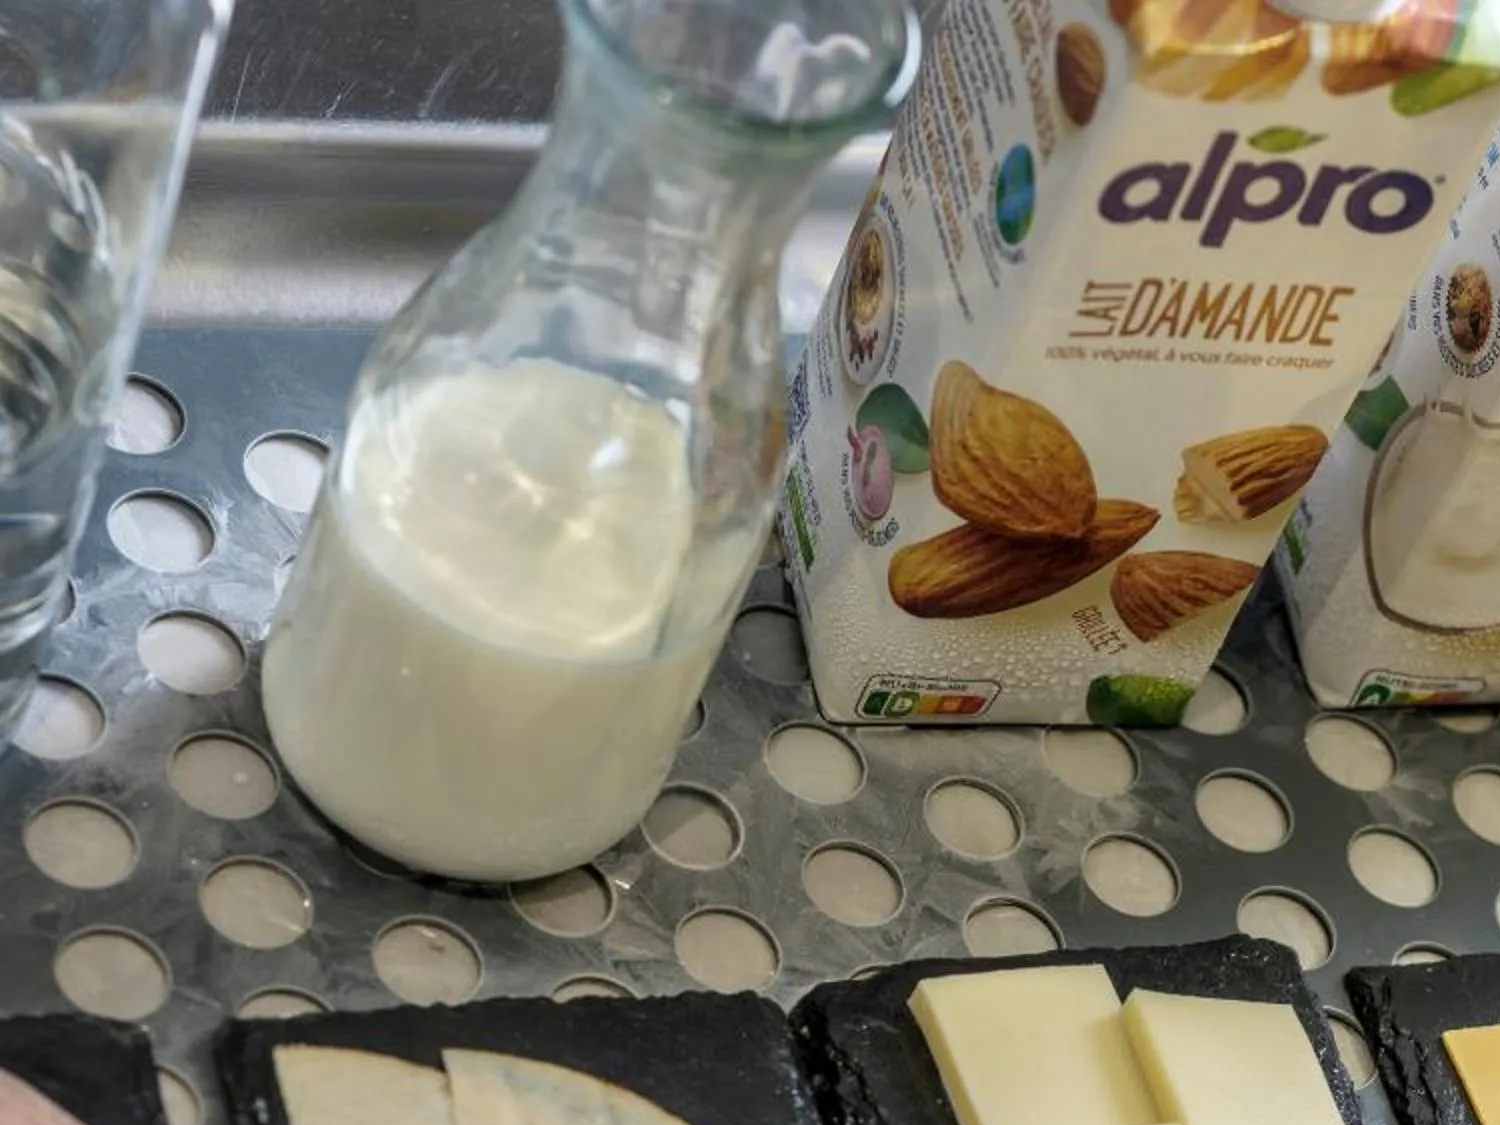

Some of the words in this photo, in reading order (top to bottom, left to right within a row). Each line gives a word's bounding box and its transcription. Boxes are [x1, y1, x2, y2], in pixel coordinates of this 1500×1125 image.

[1097, 131, 1436, 249] alpro
[1068, 279, 1133, 338] LAIT
[1119, 277, 1356, 347] D'AMANDE
[1180, 352, 1222, 365] vous
[1224, 350, 1264, 367] faire
[1266, 354, 1336, 370] craquer
